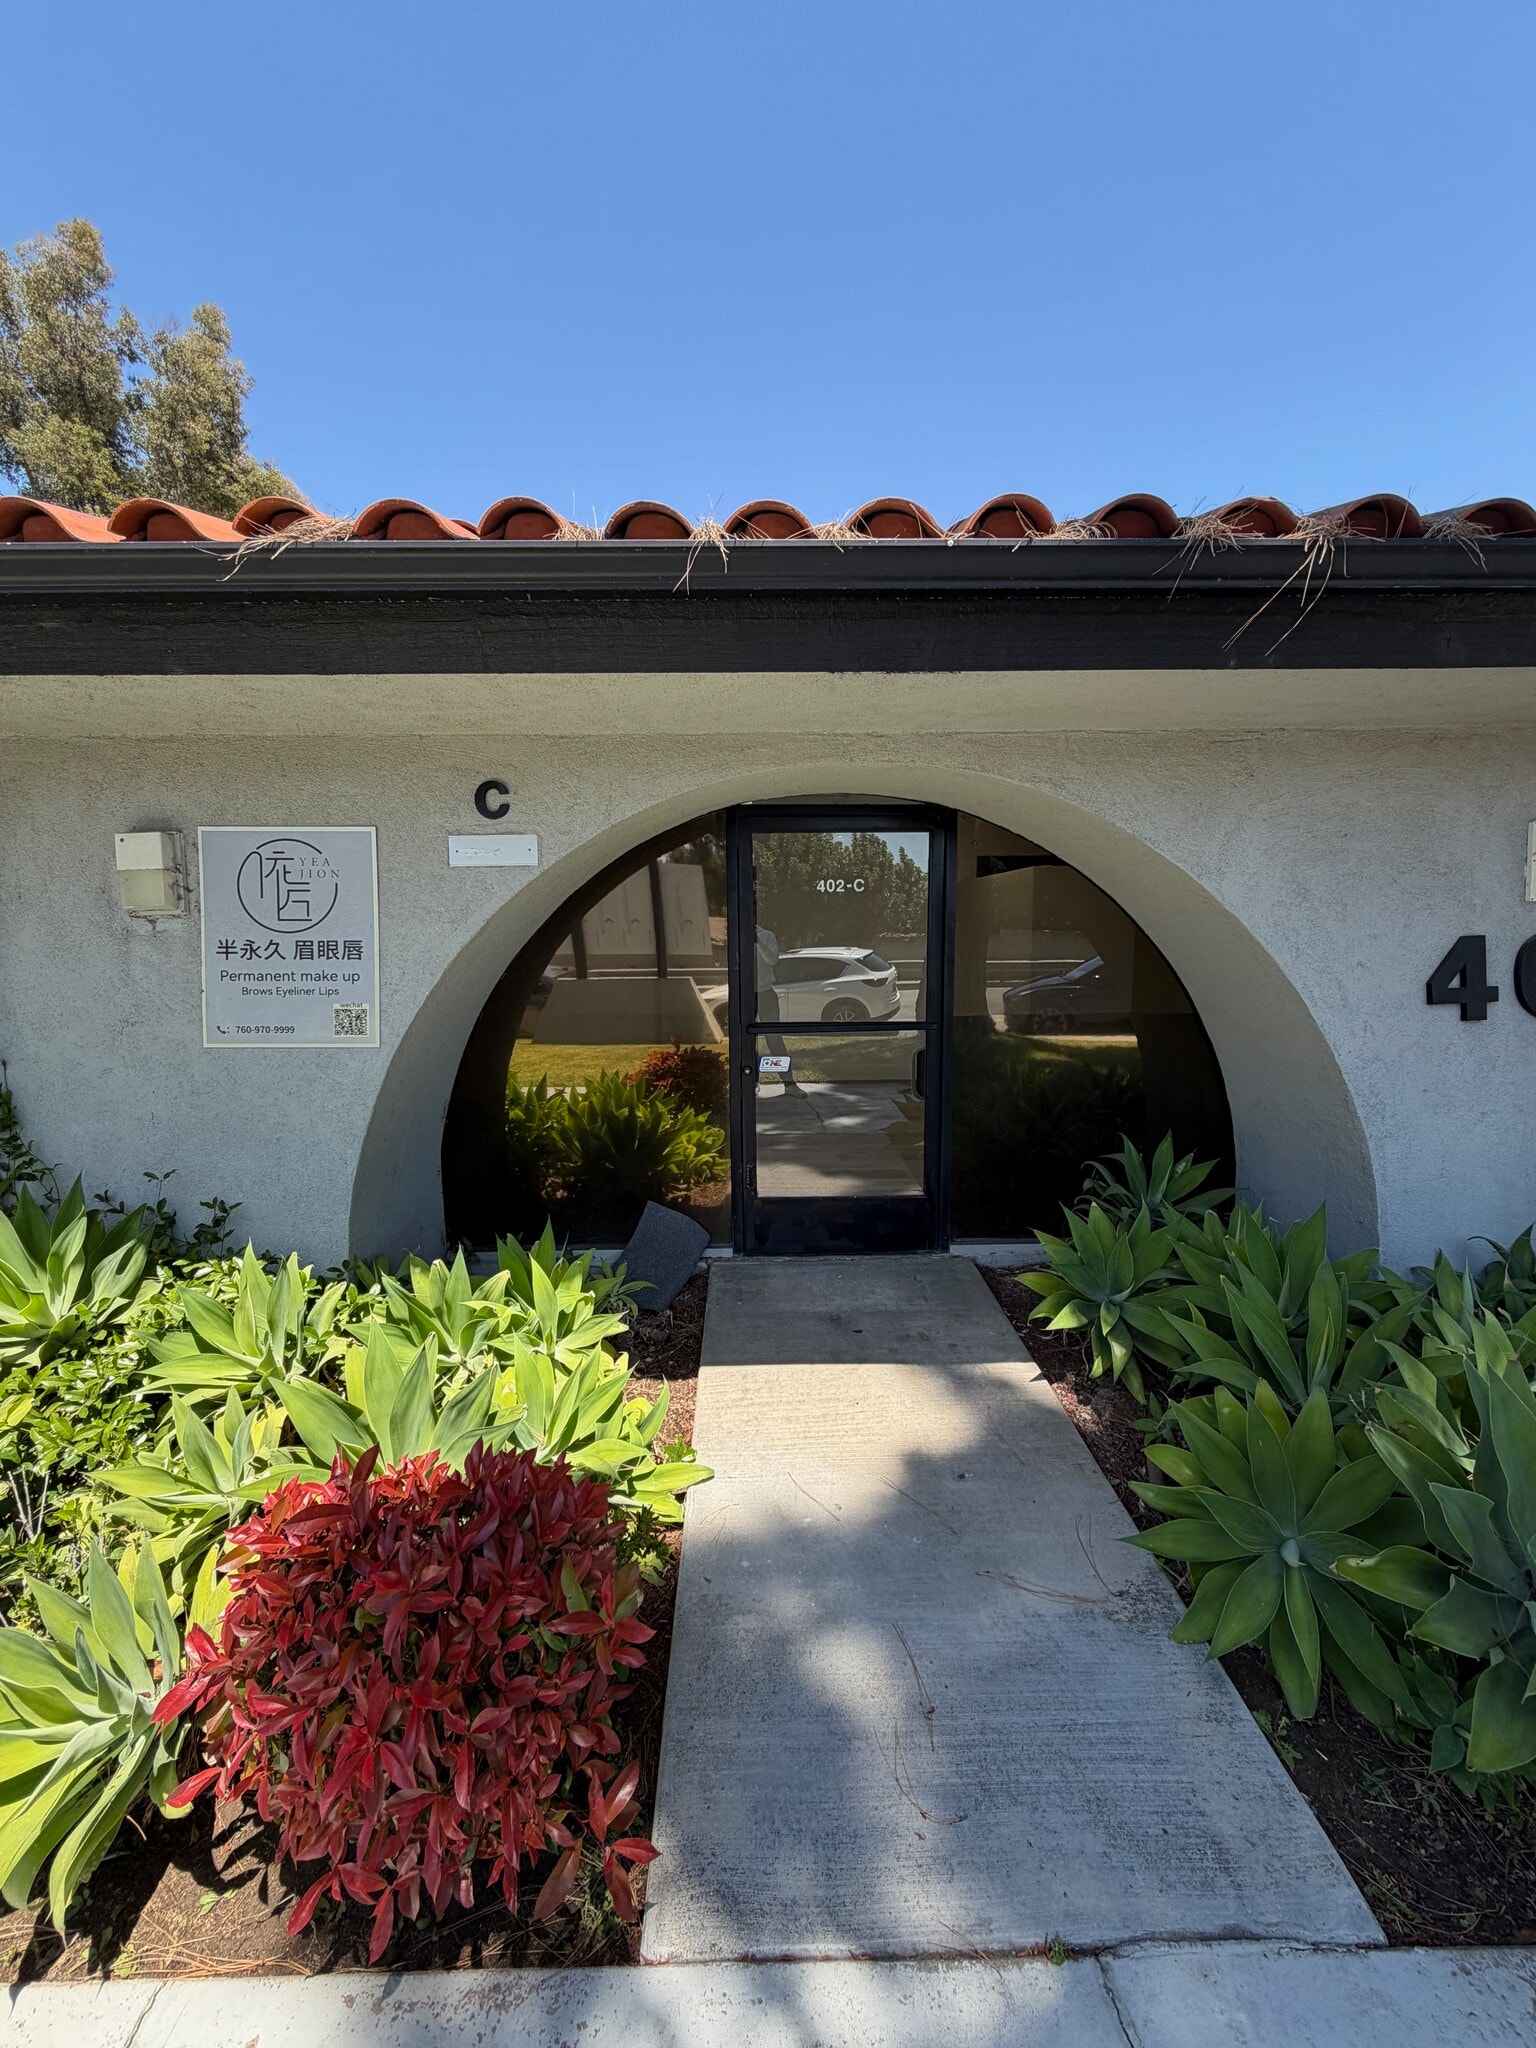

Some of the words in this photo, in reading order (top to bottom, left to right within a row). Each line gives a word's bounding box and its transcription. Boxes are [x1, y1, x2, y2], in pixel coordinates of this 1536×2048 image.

[474, 780, 510, 820] C
[299, 857, 331, 867] YEA
[300, 869, 340, 880] JION
[816, 878, 865, 893] 402-C
[216, 939, 286, 961] 半永久
[293, 940, 364, 961] 眉眼唇
[220, 970, 297, 982] Permanent
[300, 970, 339, 982] make
[342, 972, 361, 985] up
[241, 986, 273, 996] Brows
[276, 986, 316, 998] Eyeliner
[318, 986, 340, 998] Lips
[235, 1025, 296, 1034] 760-970-9999
